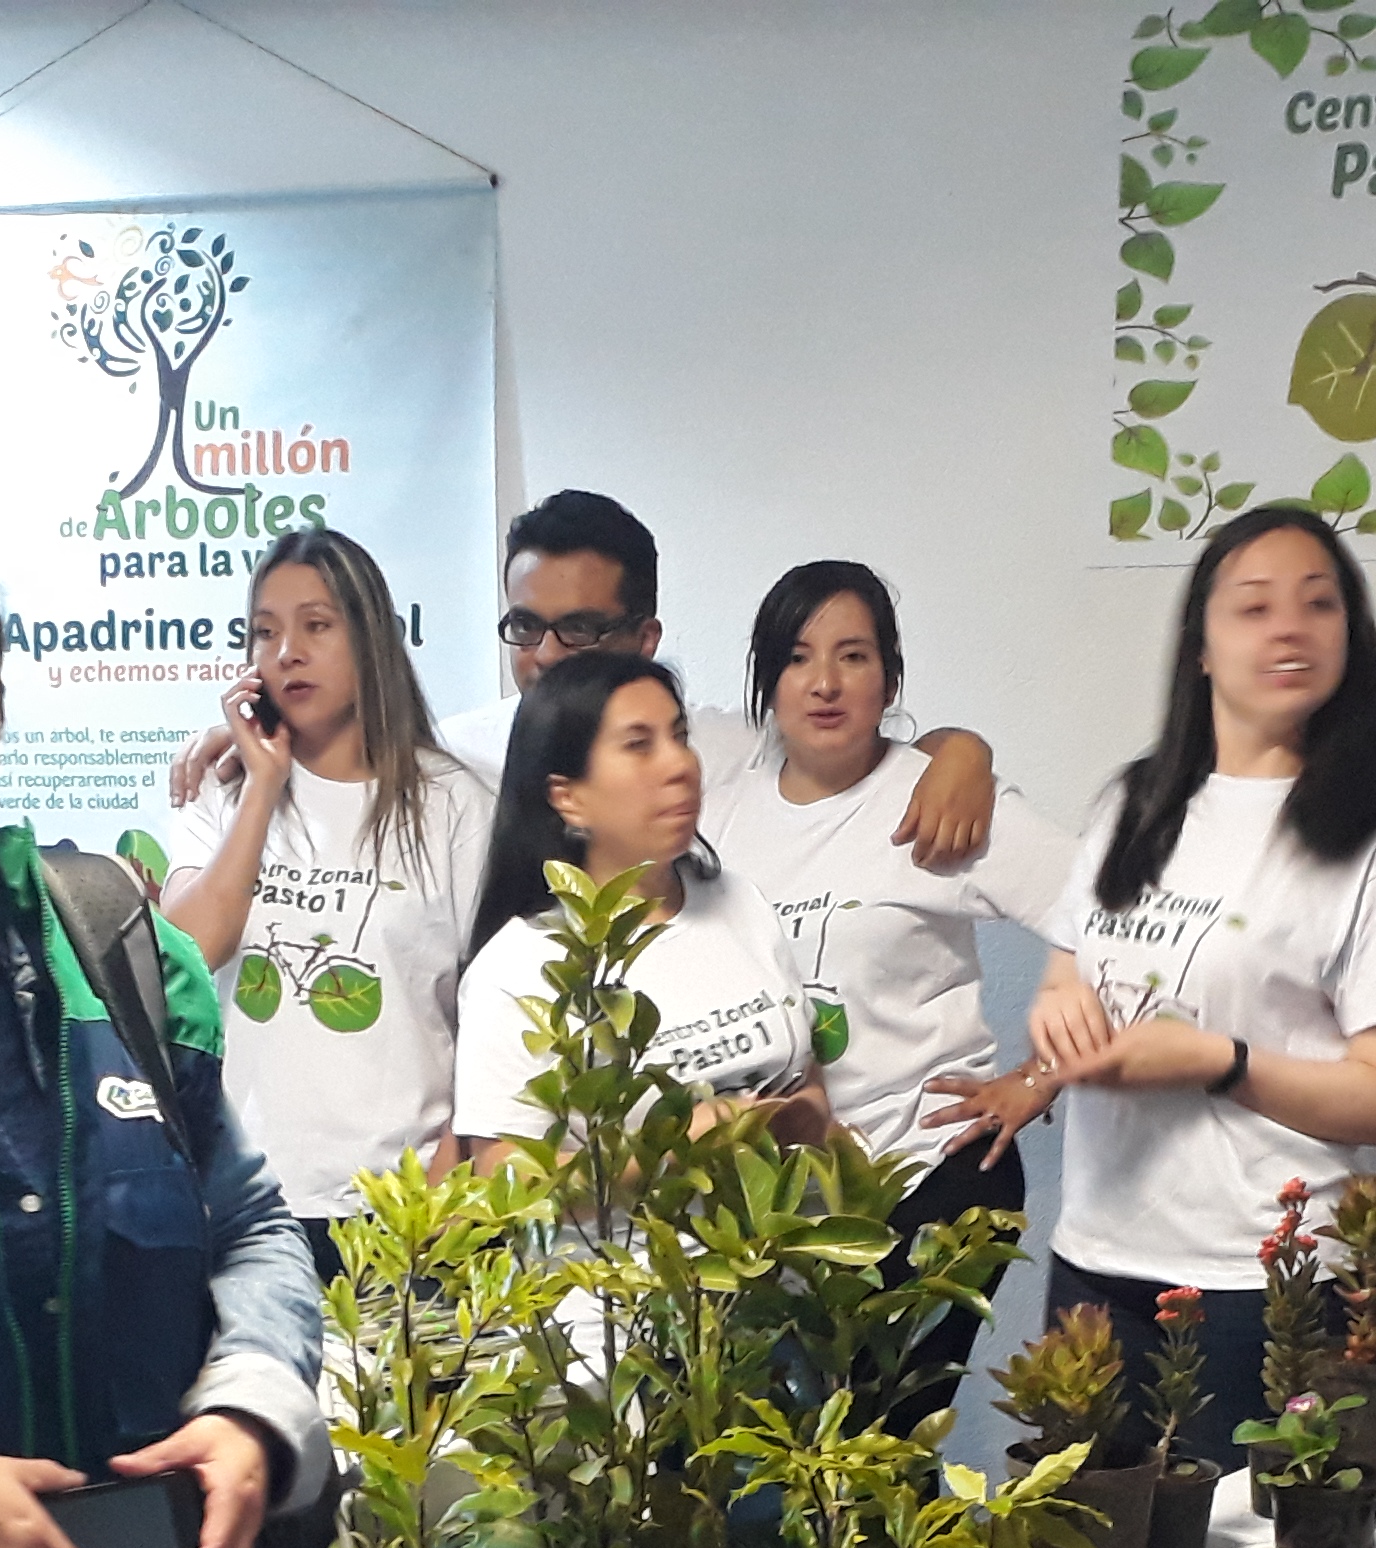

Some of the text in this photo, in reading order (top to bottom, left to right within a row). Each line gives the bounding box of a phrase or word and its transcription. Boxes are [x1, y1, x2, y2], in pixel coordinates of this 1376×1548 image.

[194, 400, 240, 431] Un
[193, 423, 351, 477] millón
[59, 516, 88, 538] de
[99, 550, 189, 588] para
[199, 541, 234, 578] la
[4, 607, 214, 662] Apadrine
[48, 655, 250, 689] y echemos raíce
[25, 730, 45, 744] un
[99, 728, 115, 743] te
[120, 726, 198, 744] enseñam
[18, 772, 137, 792] recuperaremos
[142, 770, 156, 788] el
[45, 792, 65, 810] de
[69, 791, 83, 809] la
[87, 790, 139, 810] ciudad
[306, 868, 374, 887] Zonal
[334, 888, 347, 913] 1
[709, 989, 776, 1029] Zonal
[670, 1020, 773, 1078] Pasto 1
